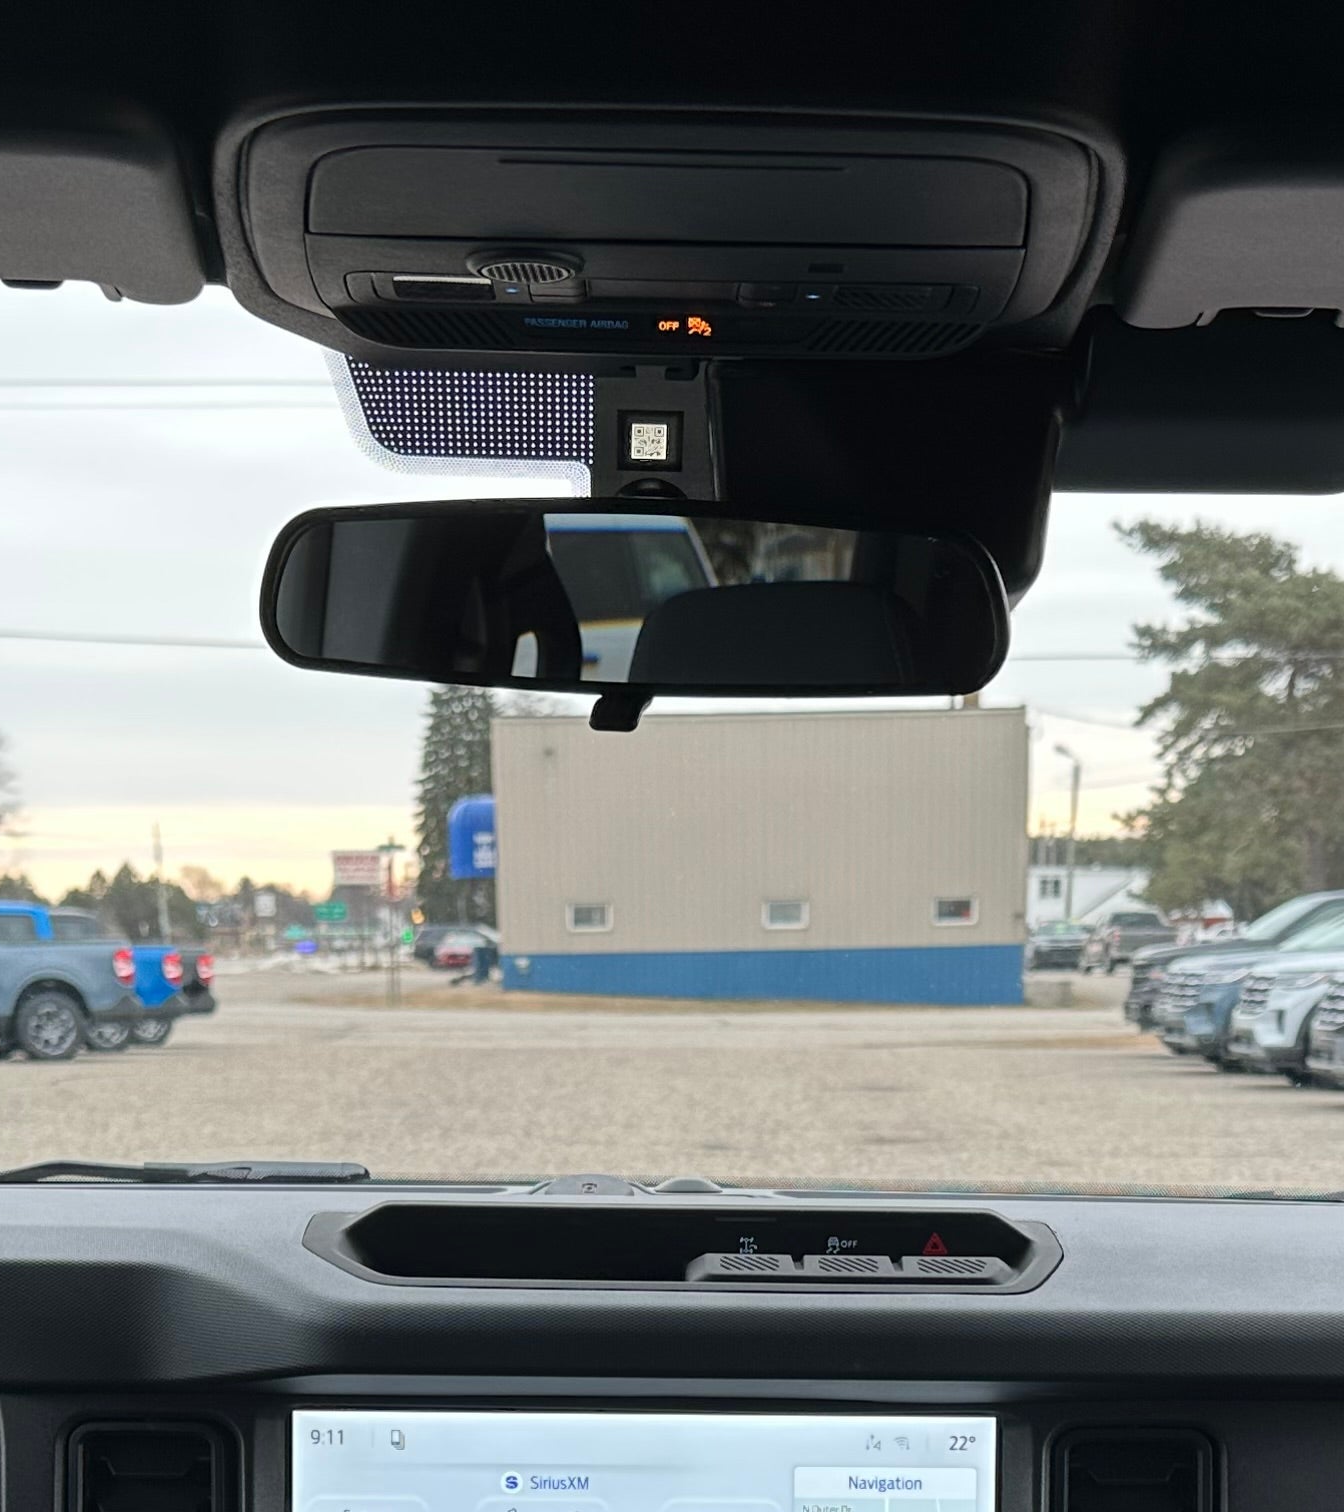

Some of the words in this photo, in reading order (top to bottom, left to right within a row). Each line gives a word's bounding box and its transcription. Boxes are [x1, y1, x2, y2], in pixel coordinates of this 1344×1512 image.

[524, 317, 587, 329] PASSENGER
[590, 320, 628, 330] AIRBAG
[658, 320, 679, 332] OFF
[840, 1240, 857, 1249] OFF
[310, 1430, 344, 1445] 9:11
[949, 1435, 976, 1451] 22°
[530, 1476, 589, 1490] SiriusXM
[848, 1476, 922, 1492] Navigation
